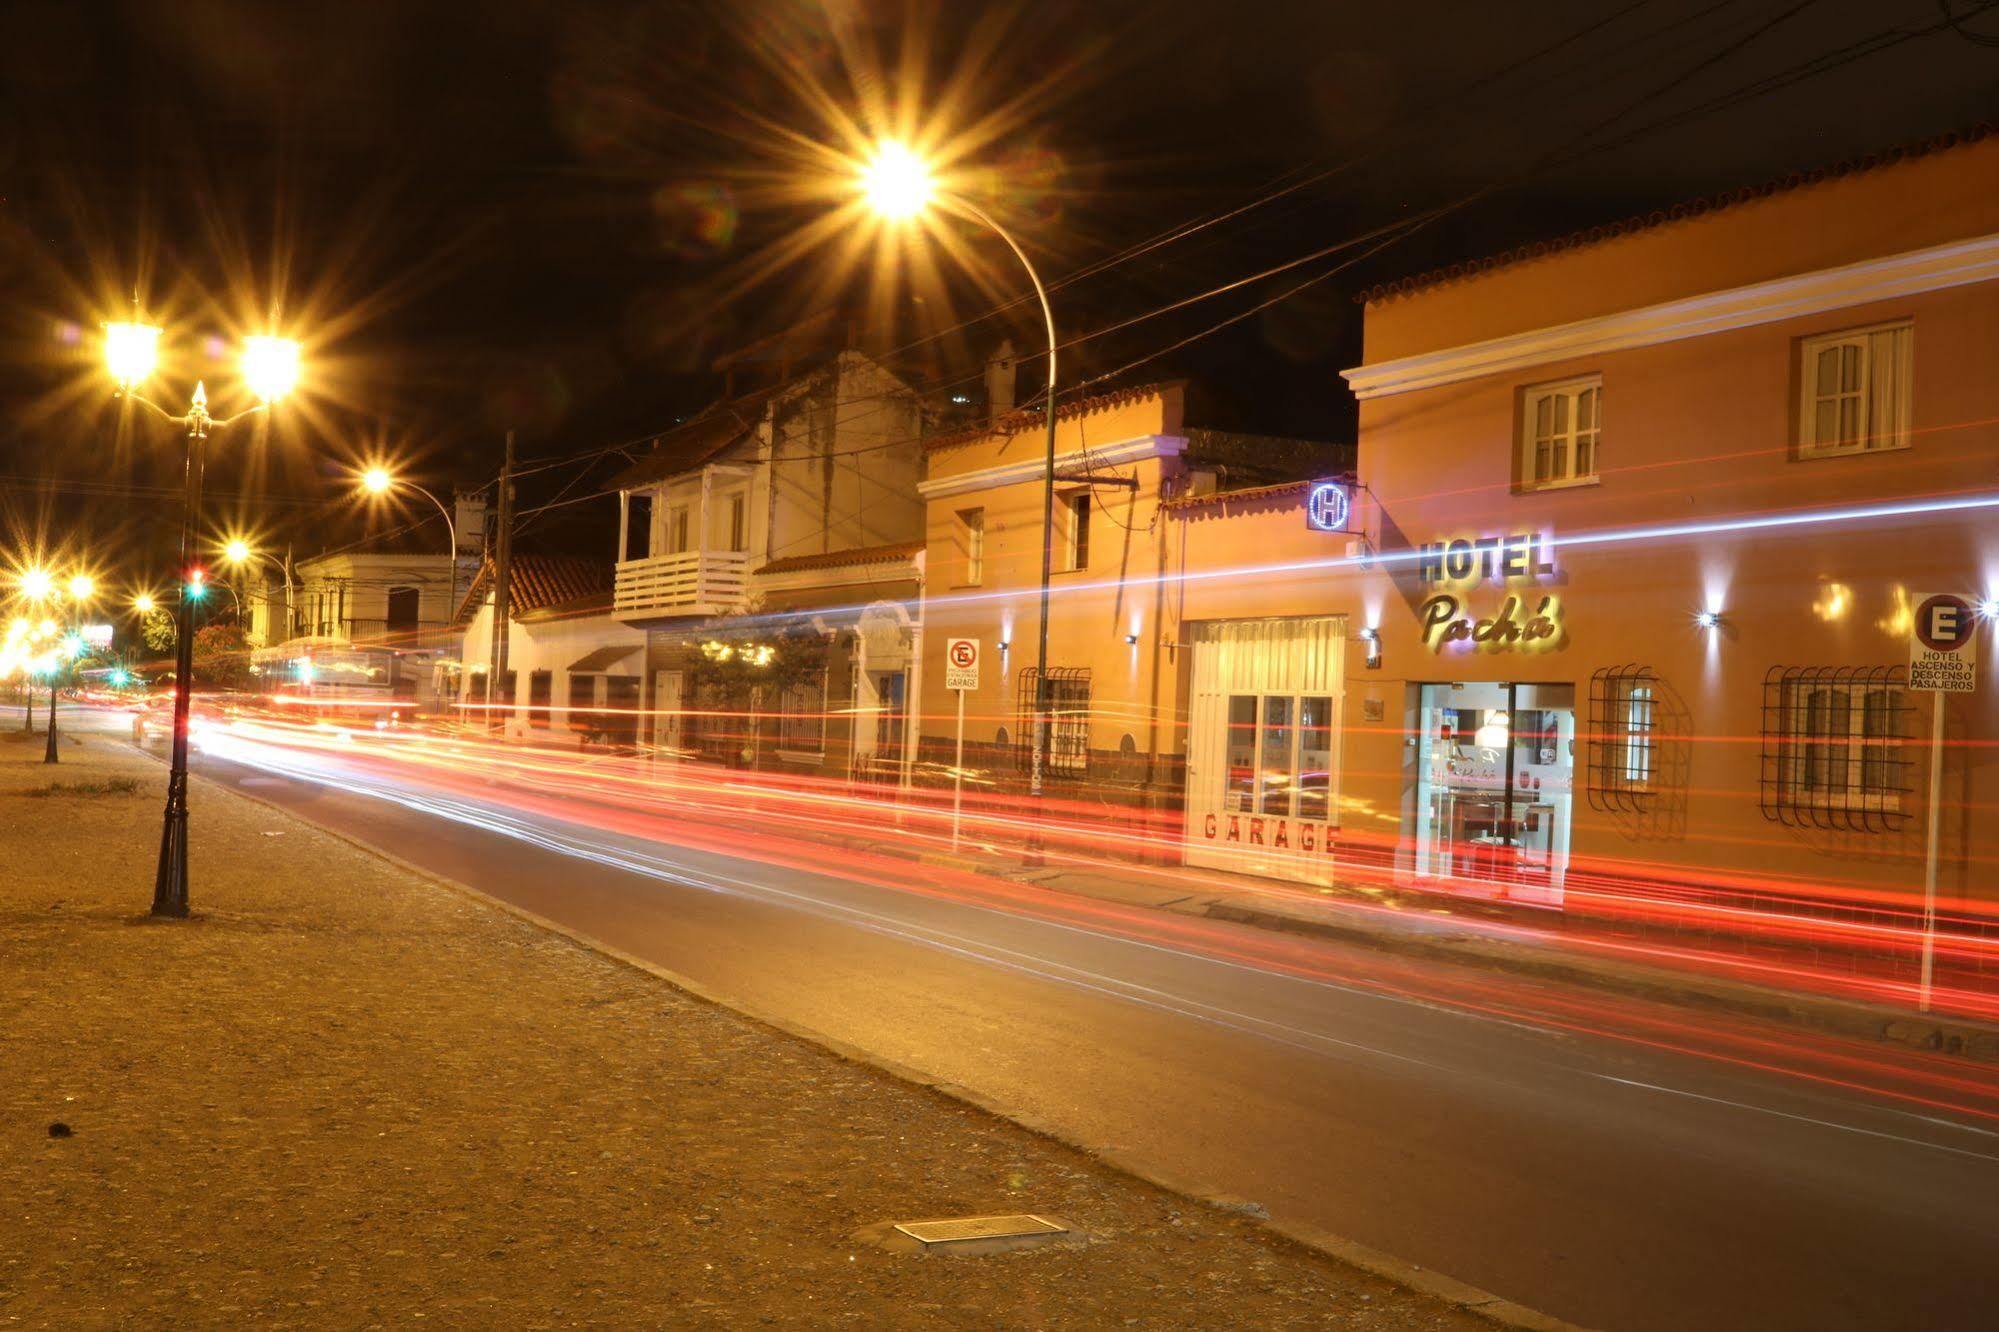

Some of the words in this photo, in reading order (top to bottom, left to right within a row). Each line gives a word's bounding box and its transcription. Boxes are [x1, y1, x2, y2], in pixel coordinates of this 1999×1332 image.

[1317, 488, 1341, 526] H
[1419, 533, 1553, 581] HOTEL
[1420, 594, 1556, 645] Pachá
[1931, 606, 1957, 641] E
[1911, 660, 1964, 671] ASCENSO
[1967, 662, 1975, 672] Y
[1923, 651, 1963, 662] HOTEL
[947, 677, 977, 688] GARAGE
[1910, 679, 1974, 691] PASAJEROS
[1911, 669, 1973, 681] DESCENSO
[1204, 813, 1342, 853] GARAGE
